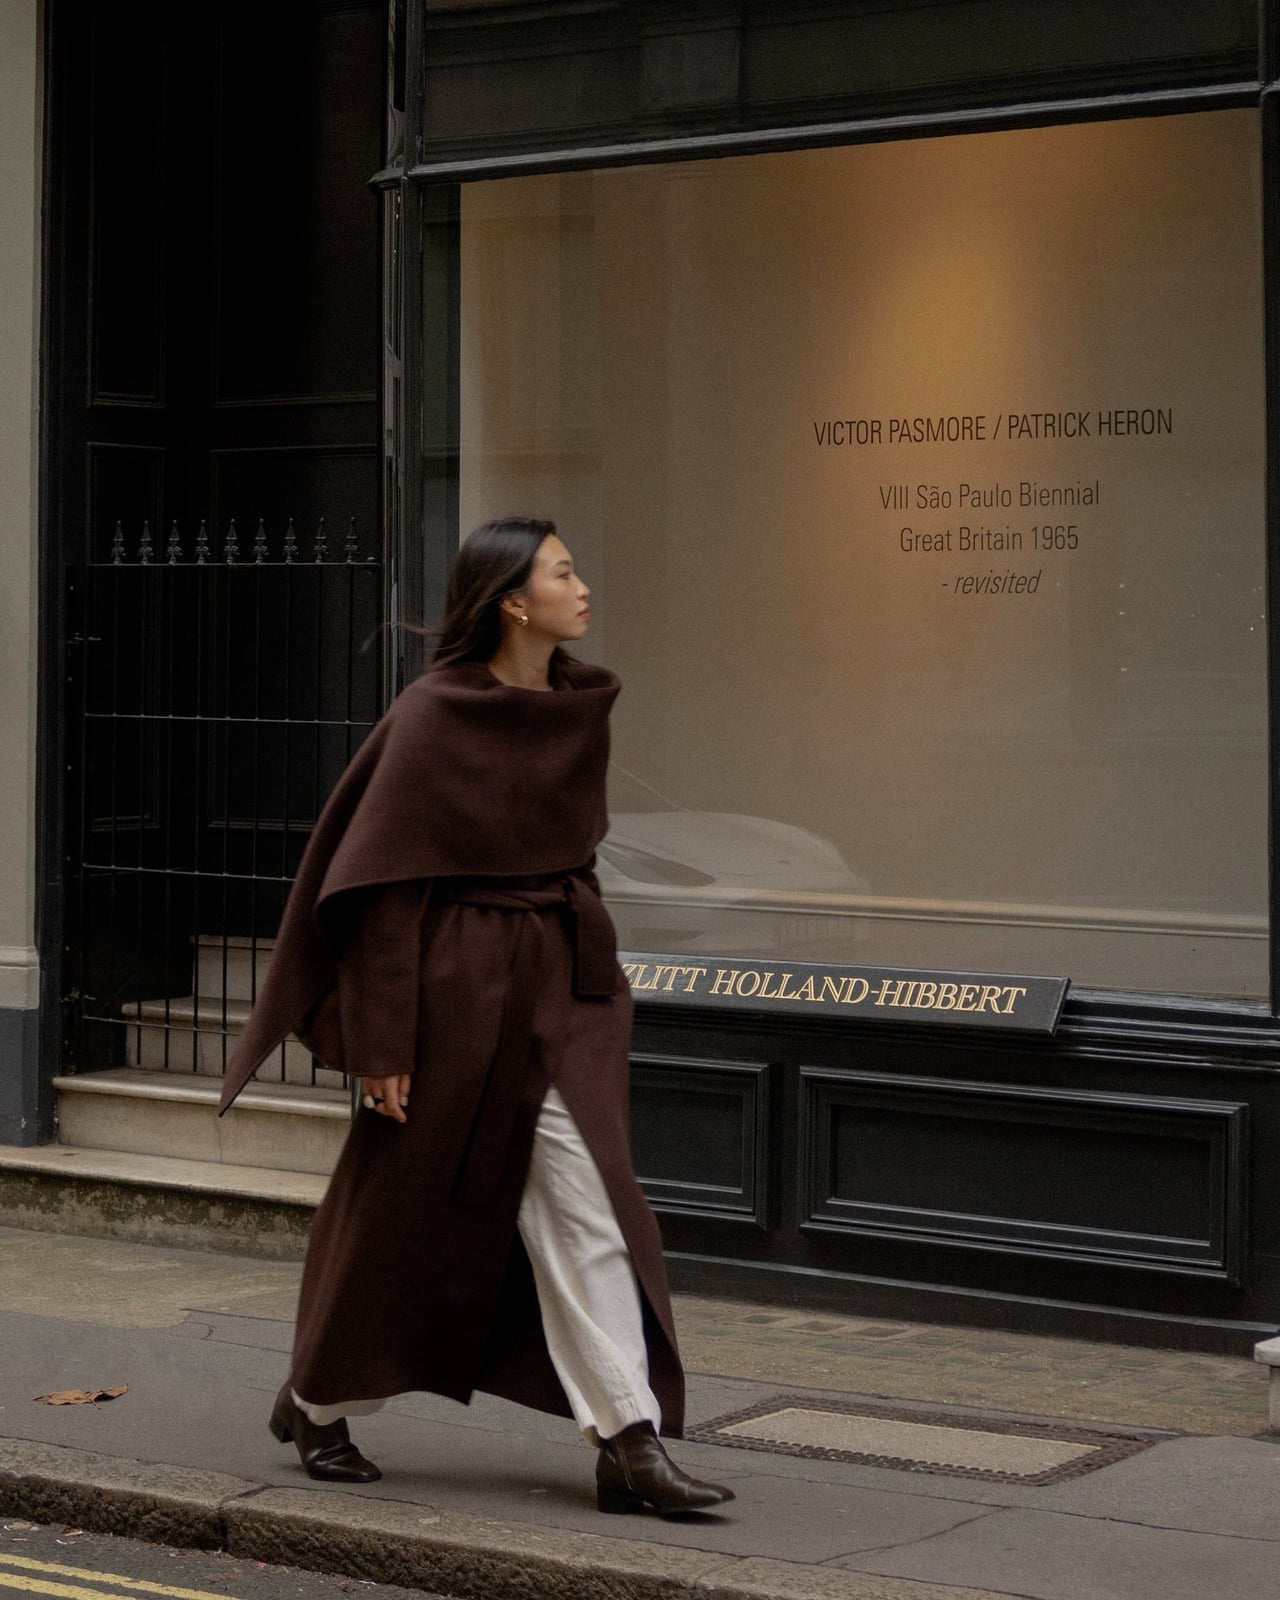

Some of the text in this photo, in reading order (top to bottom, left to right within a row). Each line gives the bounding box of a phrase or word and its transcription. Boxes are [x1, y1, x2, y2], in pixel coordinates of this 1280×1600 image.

[814, 409, 1173, 445] VICTOR PASMORE / PATRICK HERON
[880, 481, 1100, 509] VIII São Paulo Biennial
[901, 525, 1079, 552] Great Britain 1965
[954, 569, 1041, 595] revisited
[709, 969, 1026, 1014] HOLLAND-HIBBERT
